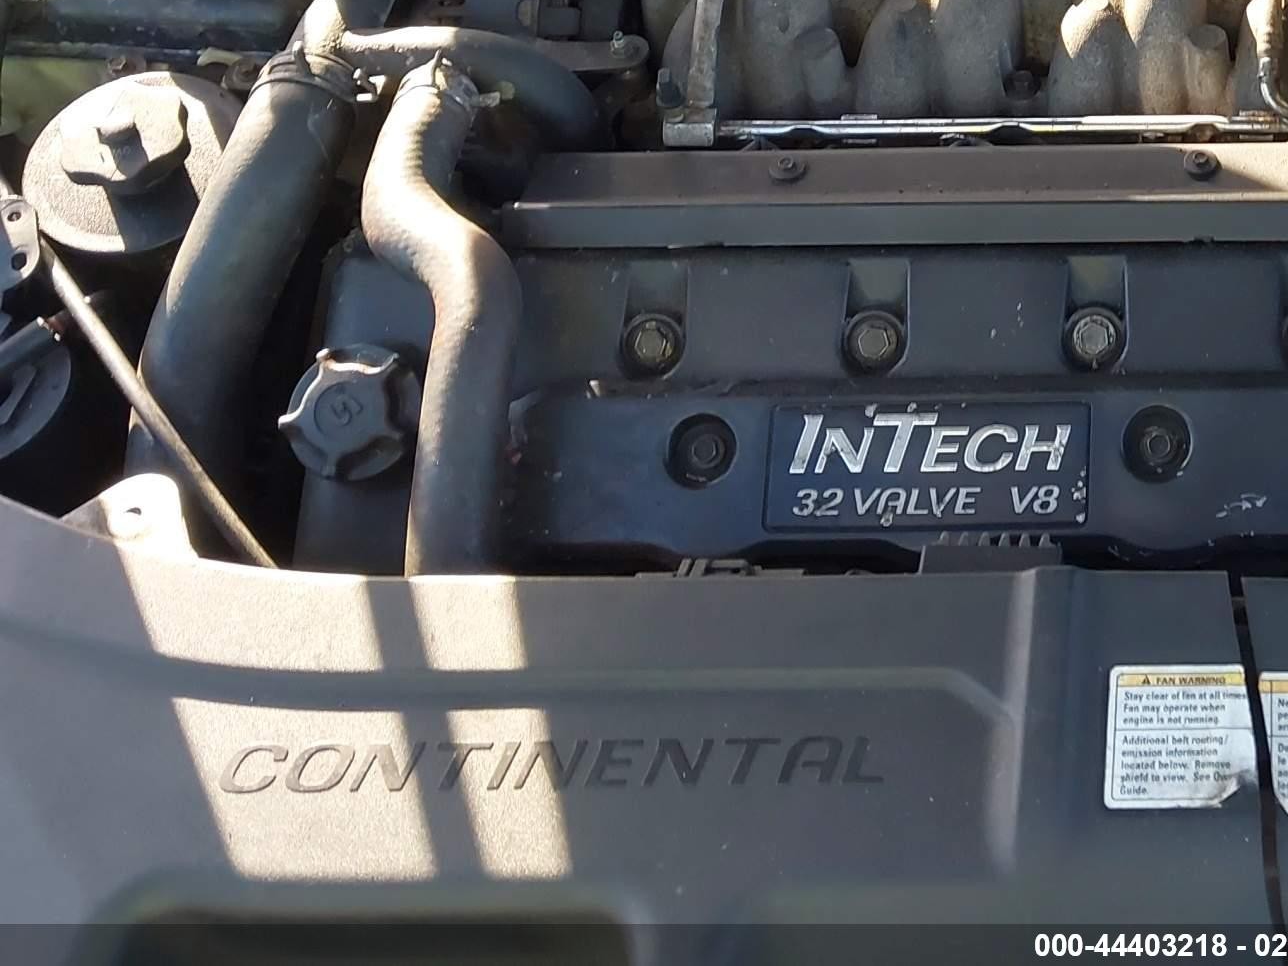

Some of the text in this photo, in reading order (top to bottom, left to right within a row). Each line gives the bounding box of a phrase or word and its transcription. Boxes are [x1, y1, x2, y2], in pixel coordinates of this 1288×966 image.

[792, 485, 1060, 517] 32 VALVE V8
[1156, 676, 1226, 685] FAN WARNING
[1124, 691, 1143, 702] Stay
[1146, 691, 1169, 700] clear
[1171, 691, 1180, 700] of
[1182, 691, 1196, 700] fan
[1198, 691, 1207, 700] at
[1209, 691, 1220, 700] all
[1123, 703, 1226, 714] Fan may operate when
[1123, 715, 1154, 726] engine
[1156, 715, 1164, 724] is
[1167, 715, 1182, 724] not
[1122, 734, 1169, 745] Additional
[1171, 735, 1189, 744] belt
[1121, 747, 1218, 757] emission information
[219, 734, 885, 795] CONTINENTAL
[1120, 760, 1156, 770] located
[1194, 760, 1231, 770] Remove
[1120, 773, 1149, 782] shield
[1151, 773, 1160, 782] to
[1193, 772, 1211, 782] See
